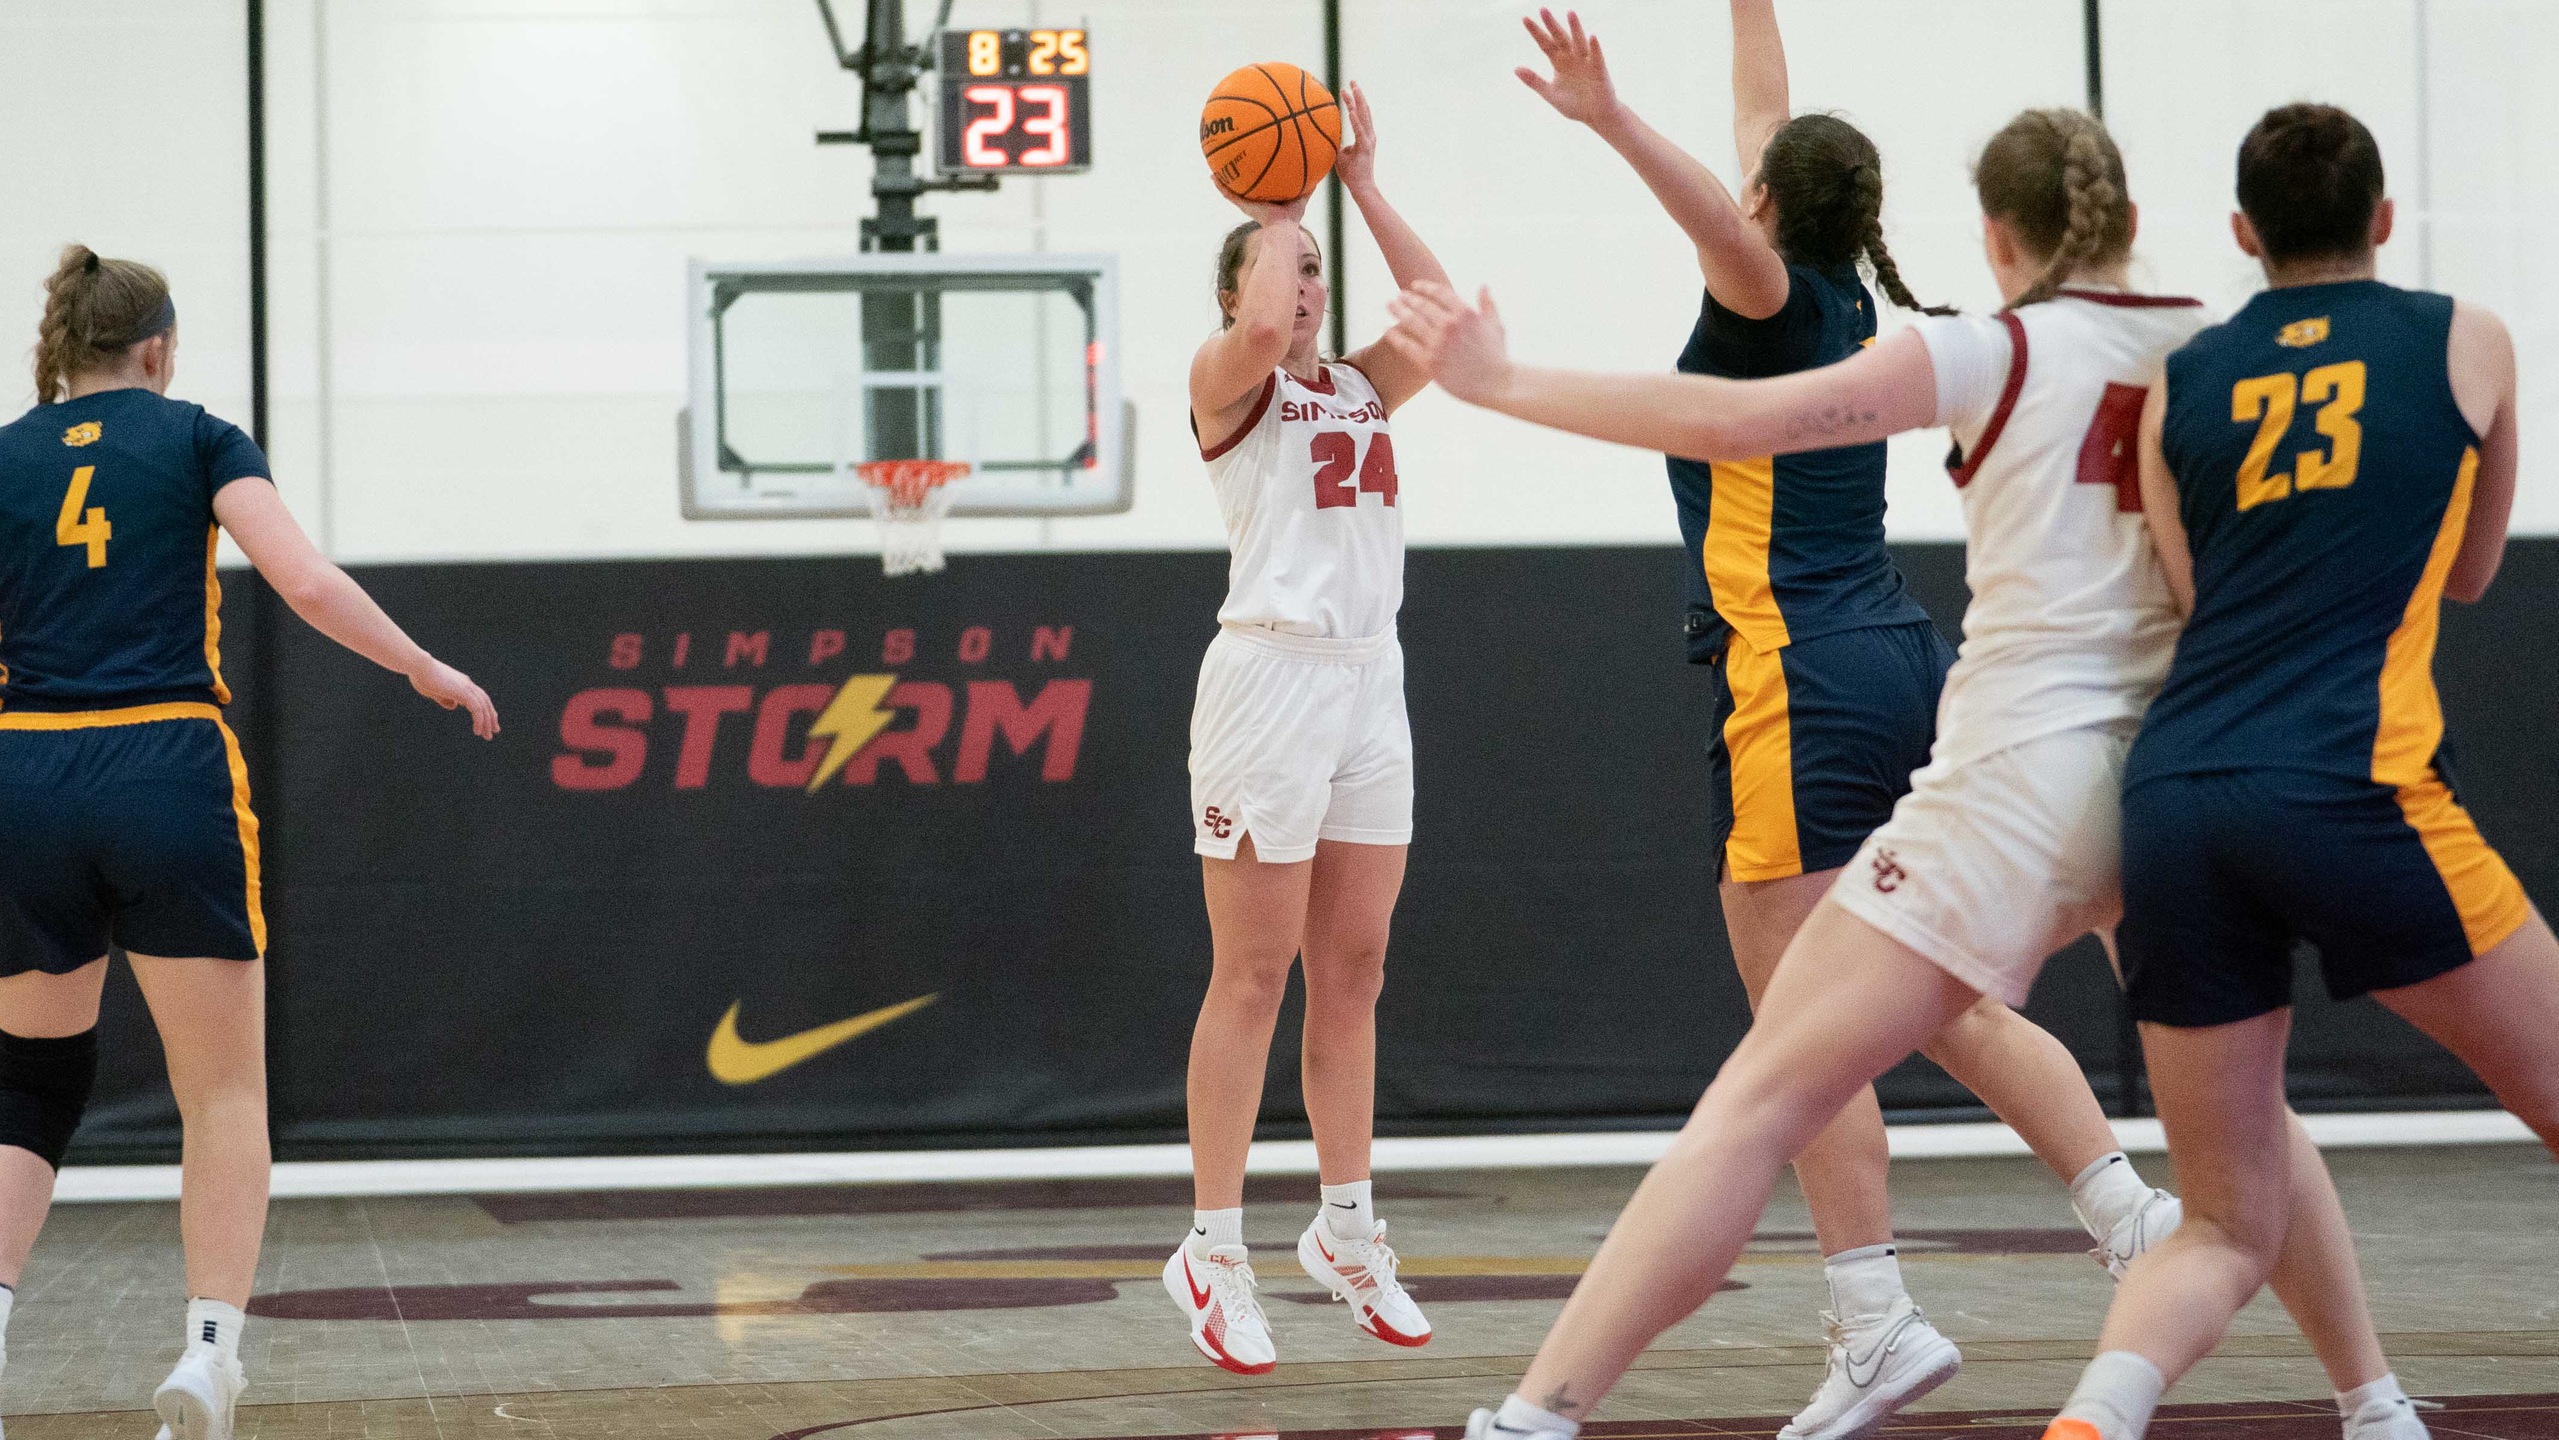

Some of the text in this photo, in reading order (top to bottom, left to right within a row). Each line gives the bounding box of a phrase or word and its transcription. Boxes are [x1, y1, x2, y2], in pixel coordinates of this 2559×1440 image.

[963, 84, 1070, 167] 23
[1281, 400, 1389, 424] SIMSON
[2231, 359, 2367, 512] 23
[1309, 431, 1398, 510] 24
[56, 466, 112, 568] 4
[609, 625, 1073, 670] SIMPSON
[551, 677, 1093, 792] STORM
